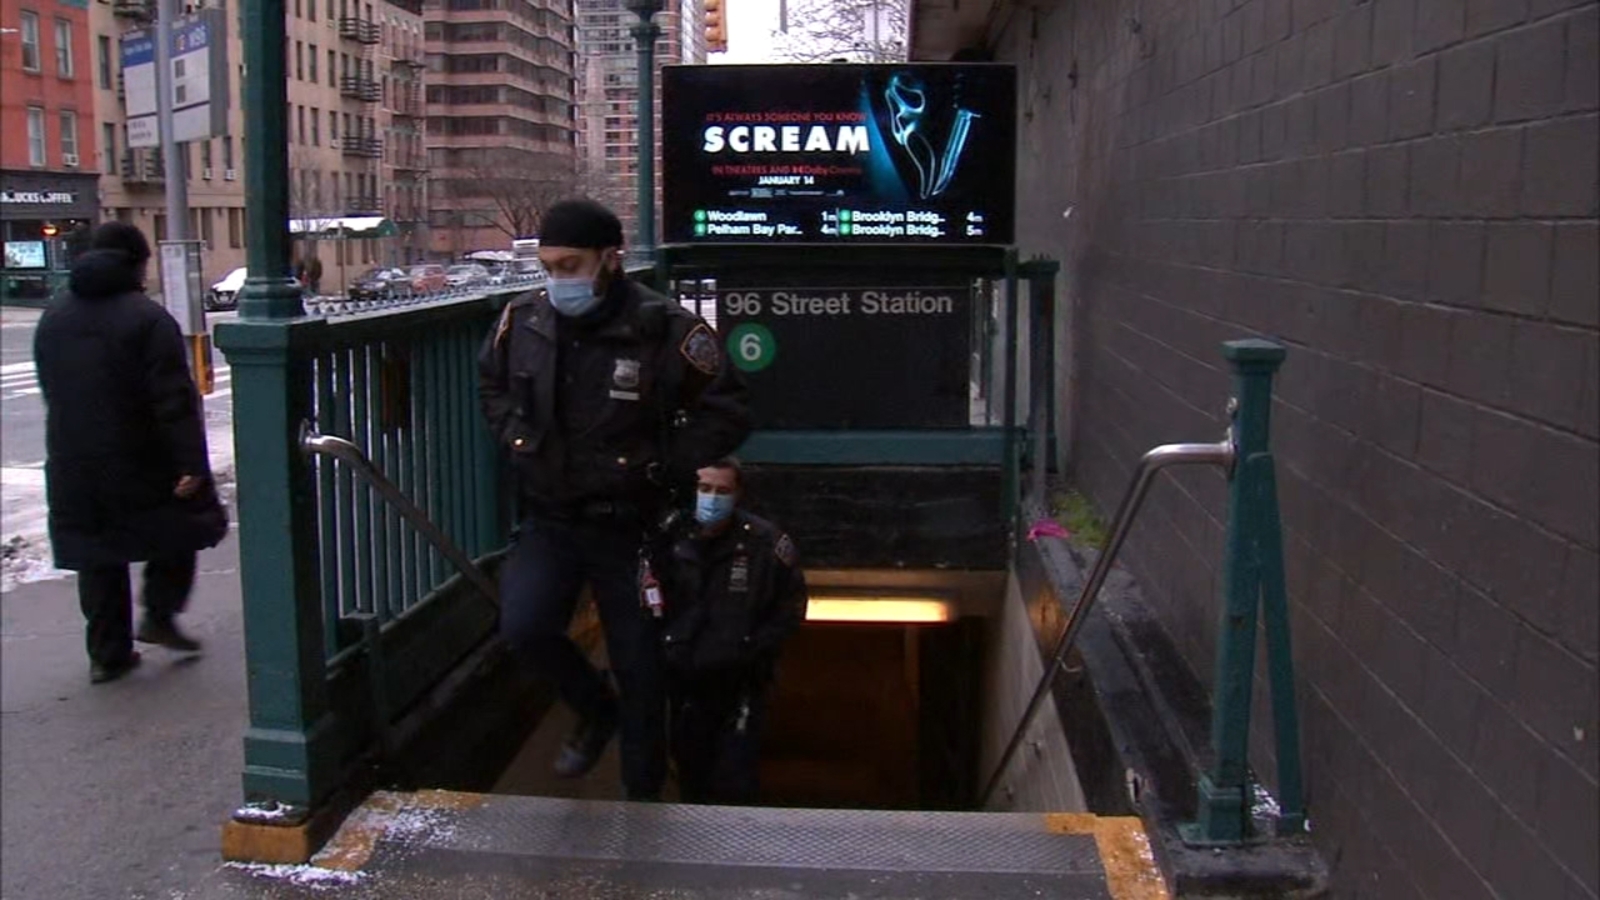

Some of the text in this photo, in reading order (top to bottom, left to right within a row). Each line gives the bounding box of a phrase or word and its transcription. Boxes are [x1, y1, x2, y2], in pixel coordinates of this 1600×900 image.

[706, 112, 867, 121] IT'S ALWAYS SOMEONE YOU KNOW
[703, 125, 870, 155] SCREAM
[770, 165, 790, 174] AND
[758, 176, 814, 185] JANUARY 14
[707, 210, 767, 221] Woodlawn
[852, 211, 904, 224] Brooklyn
[966, 211, 983, 222] 4m
[707, 223, 750, 234] Pelham
[752, 223, 775, 236] Bay
[852, 224, 904, 237] Brooklyn
[966, 225, 983, 236] 5m
[725, 290, 953, 316] 96 Street Station
[739, 333, 762, 361] 6
